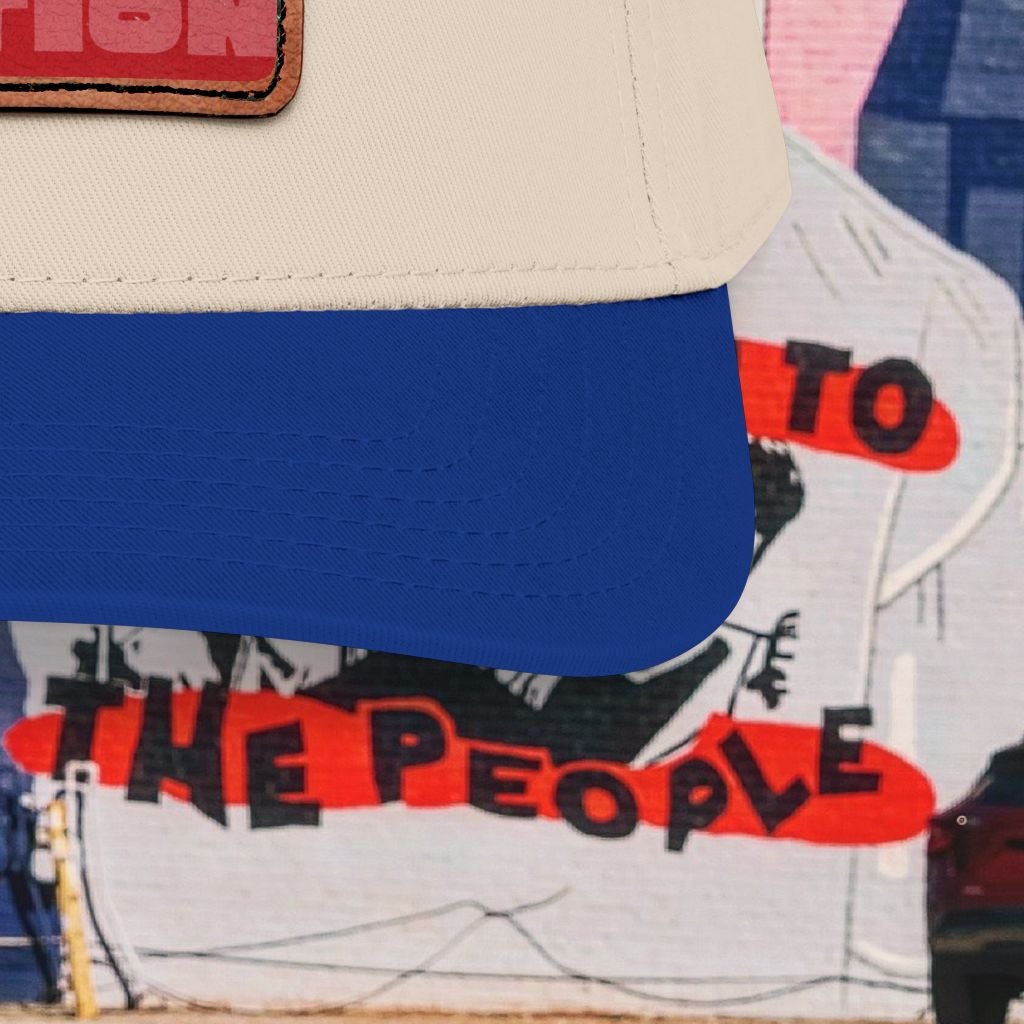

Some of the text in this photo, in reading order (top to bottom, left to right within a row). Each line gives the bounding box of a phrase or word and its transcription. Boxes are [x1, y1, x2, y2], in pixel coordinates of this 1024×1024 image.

[784, 340, 933, 454] TO
[46, 675, 882, 852] THE PEOPLE
